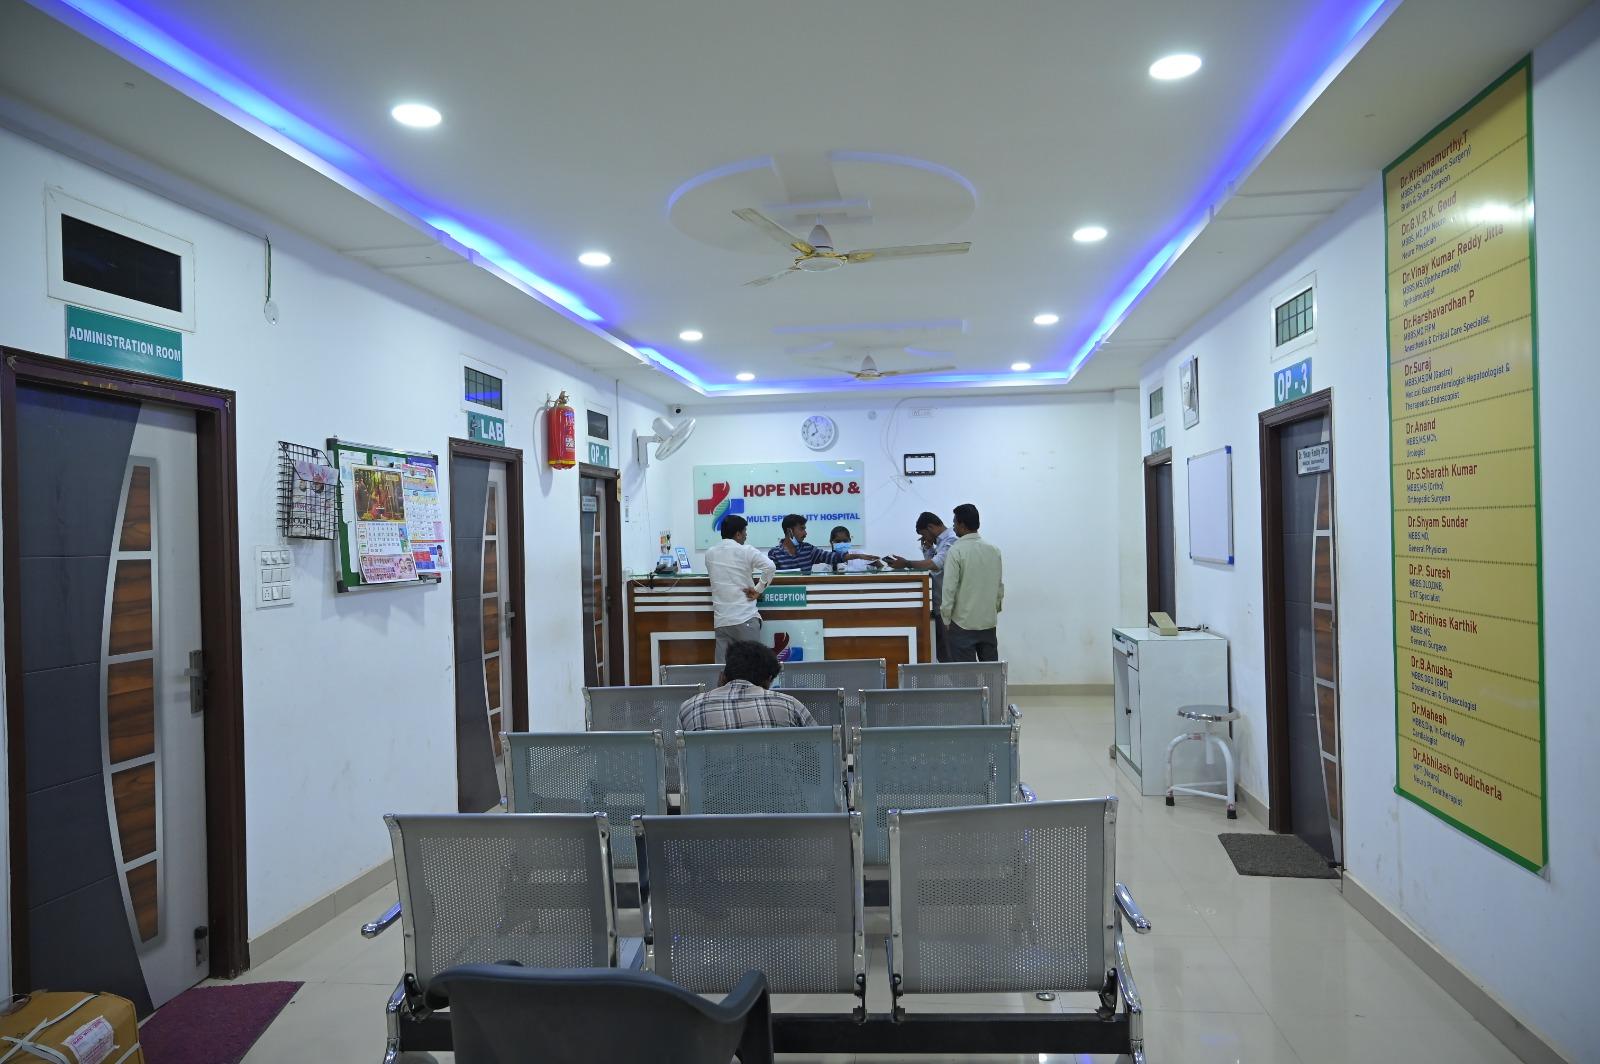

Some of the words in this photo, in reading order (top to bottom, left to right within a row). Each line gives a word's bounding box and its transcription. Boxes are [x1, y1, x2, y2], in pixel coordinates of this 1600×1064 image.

[1438, 190, 1456, 214] Goud
[1402, 263, 1430, 284] Dr.Vinay
[1431, 248, 1455, 269] Kumar
[1458, 234, 1481, 256] Reddy
[1484, 224, 1504, 242] Jitta
[1403, 296, 1466, 330] Dr.Harshavardhan
[1469, 289, 1475, 303] P
[1450, 327, 1462, 336] Care
[69, 326, 154, 356] ADMINISTRATION
[156, 345, 181, 362] ROOM
[1404, 357, 1432, 376] Dr.Suraj
[1506, 362, 1510, 372] &
[1277, 370, 1292, 401] OP
[1301, 363, 1307, 394] 3
[481, 418, 503, 441] LAB
[1406, 418, 1435, 434] Dr.Anand
[591, 445, 599, 462] OP
[1406, 465, 1449, 480] Dr.S.Sharath
[1452, 464, 1477, 476] Kumar
[744, 484, 786, 497] HOPE
[790, 482, 844, 496] NEURO
[848, 482, 860, 494] &
[1431, 494, 1450, 504] Surgeon
[1408, 516, 1439, 530] Dr.Shyam
[1442, 515, 1468, 528] Sundar
[1426, 545, 1447, 555] Physician
[1409, 564, 1423, 576] Dr.P.
[1426, 565, 1450, 579] Suresh
[1410, 610, 1446, 628] Dr.Srinivas
[1449, 617, 1477, 634] Karthik
[1411, 636, 1427, 647] General
[1428, 639, 1447, 652] Surgeon
[1411, 656, 1452, 679] Dr.B.Anusha
[1412, 702, 1447, 725] Dr.Mahesh
[1440, 728, 1465, 747] Cardiology
[1412, 748, 1452, 776] Dr.Abhilash
[1454, 767, 1502, 801] Goudicherla
